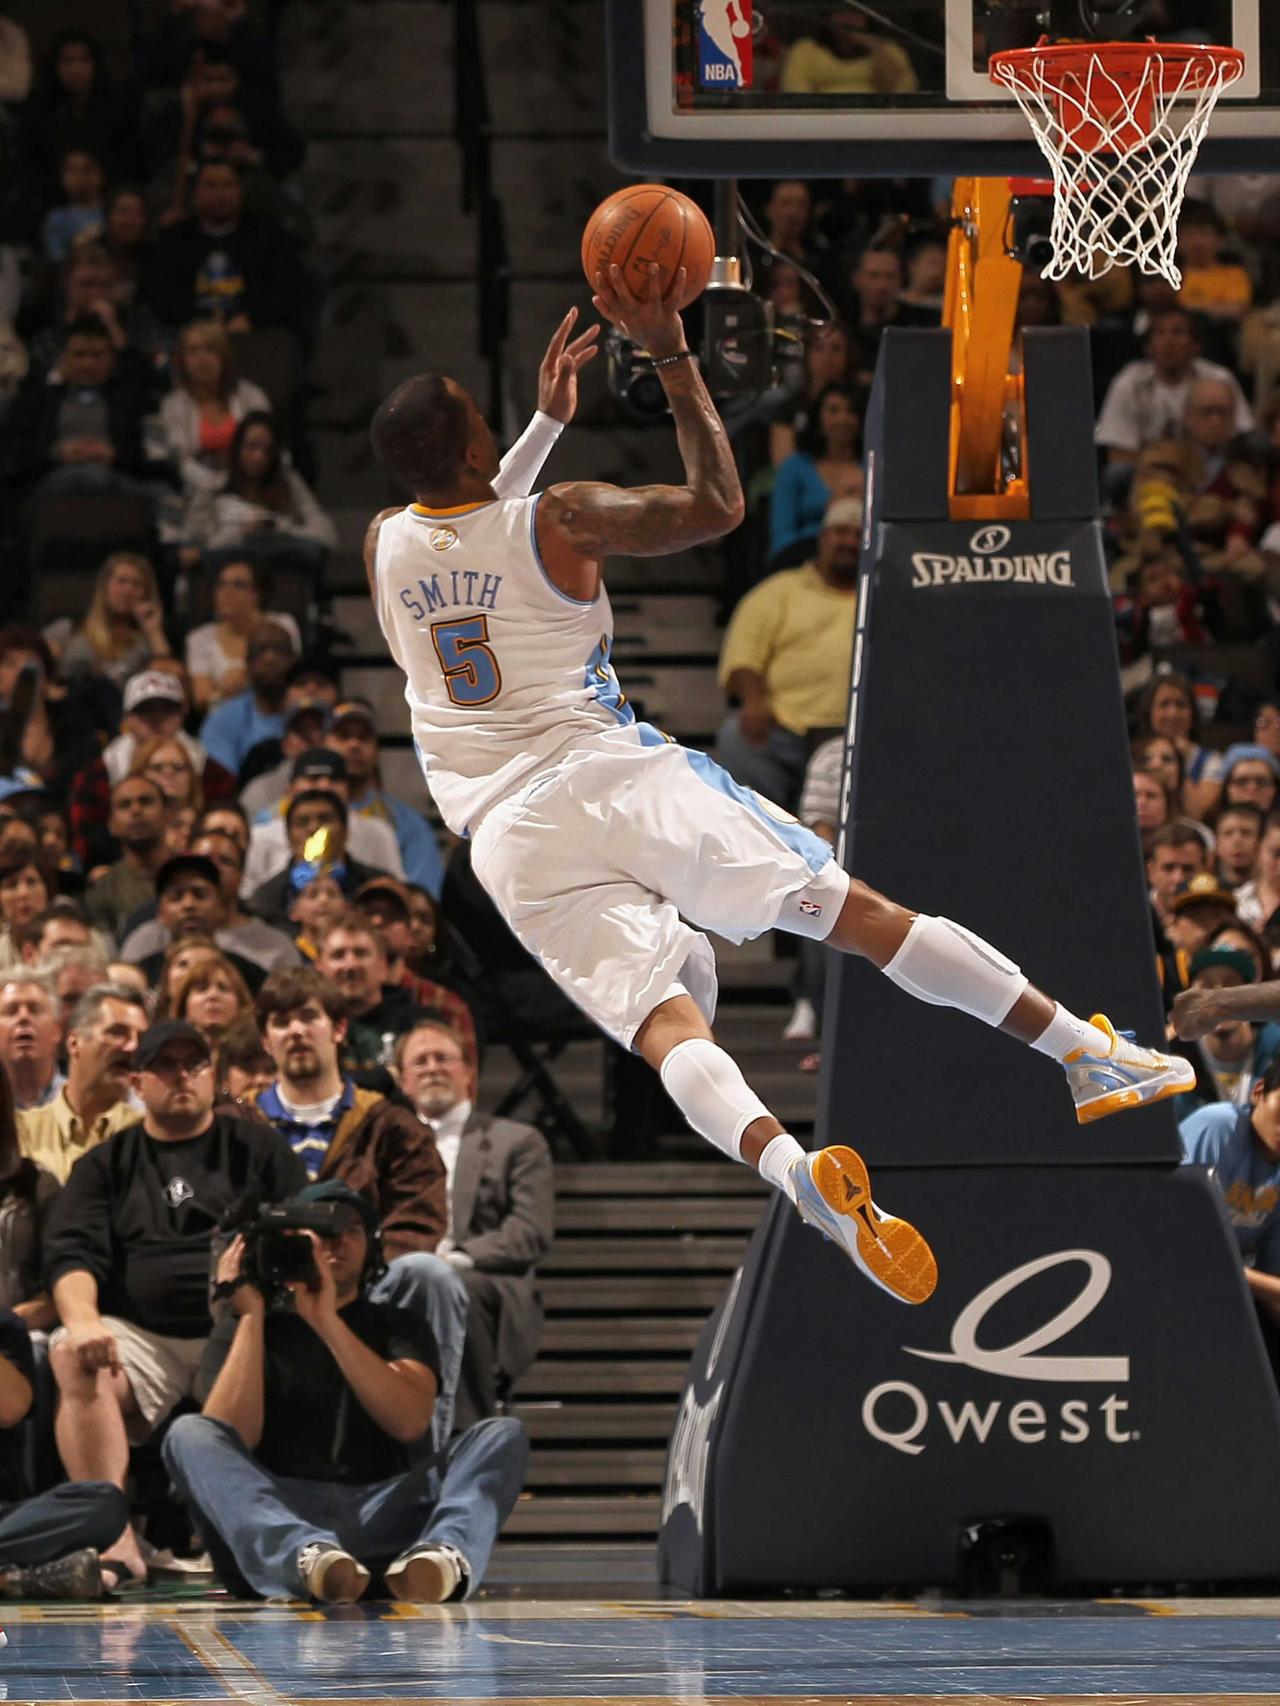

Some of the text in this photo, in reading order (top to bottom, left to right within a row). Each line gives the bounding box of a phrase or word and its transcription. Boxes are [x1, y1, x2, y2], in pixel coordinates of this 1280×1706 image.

[705, 64, 735, 81] NBA
[911, 551, 1073, 588] SPALDING
[400, 571, 503, 620] SMITH
[431, 613, 503, 707] 5
[862, 1380, 1132, 1456] Qwest
